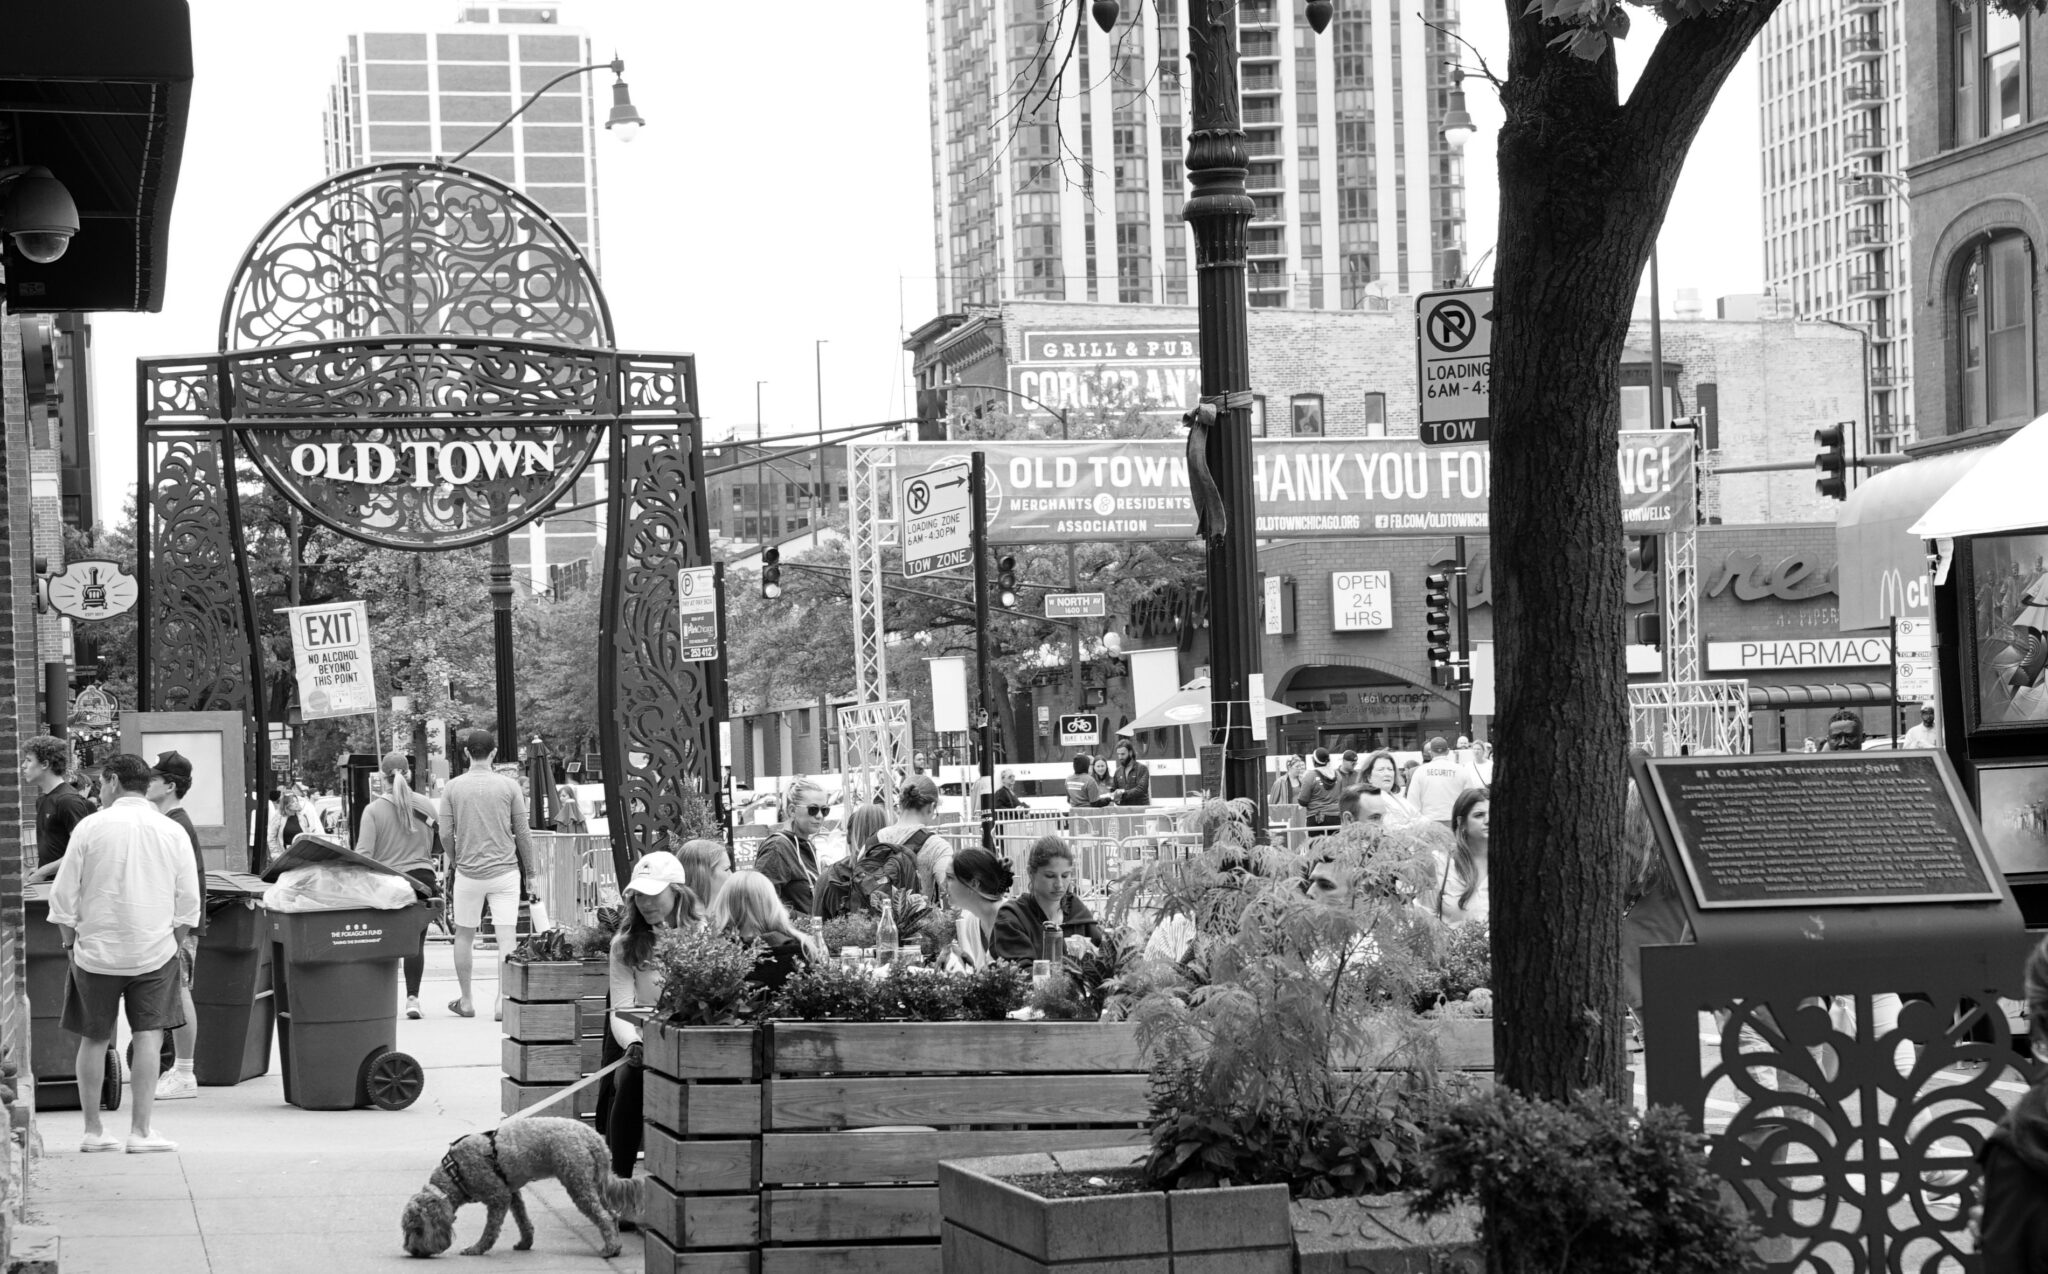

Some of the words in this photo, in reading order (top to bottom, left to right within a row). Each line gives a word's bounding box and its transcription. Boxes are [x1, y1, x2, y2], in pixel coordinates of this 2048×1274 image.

[1043, 342, 1116, 358] GRILL
[1126, 342, 1138, 356] &
[1147, 341, 1193, 356] PUB
[1428, 362, 1490, 380] LOADING
[1429, 420, 1476, 442] TOW
[291, 442, 396, 484] OLD
[401, 441, 557, 488] TOWN
[1010, 457, 1078, 488] OLD
[1088, 456, 1190, 488] TOWN
[1252, 454, 1348, 502] HANK
[1354, 452, 1428, 500] YOU
[1010, 497, 1092, 511] MERCHANTS
[1116, 497, 1192, 510] RESIDENTS
[908, 518, 938, 534] LOADING
[942, 513, 960, 526] ZONE
[1057, 520, 1147, 532] ASSOCIATION
[1390, 512, 1489, 530] FB.COM/OLDTOWNCHI
[908, 558, 932, 574] TOW
[937, 550, 966, 568] ZONE
[1337, 574, 1387, 590] OPEN
[1056, 596, 1090, 606] NORTH
[1353, 594, 1372, 608] 24
[1346, 610, 1382, 626] HRS
[306, 612, 352, 646] EXIT
[308, 654, 319, 664] NO
[322, 650, 358, 663] ALCOHOL
[318, 662, 350, 674] BEYOND
[314, 676, 332, 687] THIS
[335, 672, 358, 684] POINT
[1426, 768, 1456, 776] SECURITY
[1715, 768, 1739, 777] Old
[1740, 767, 1783, 776] Town's
[1785, 765, 1863, 775] Entrepreneur
[1864, 764, 1901, 773] Spirit
